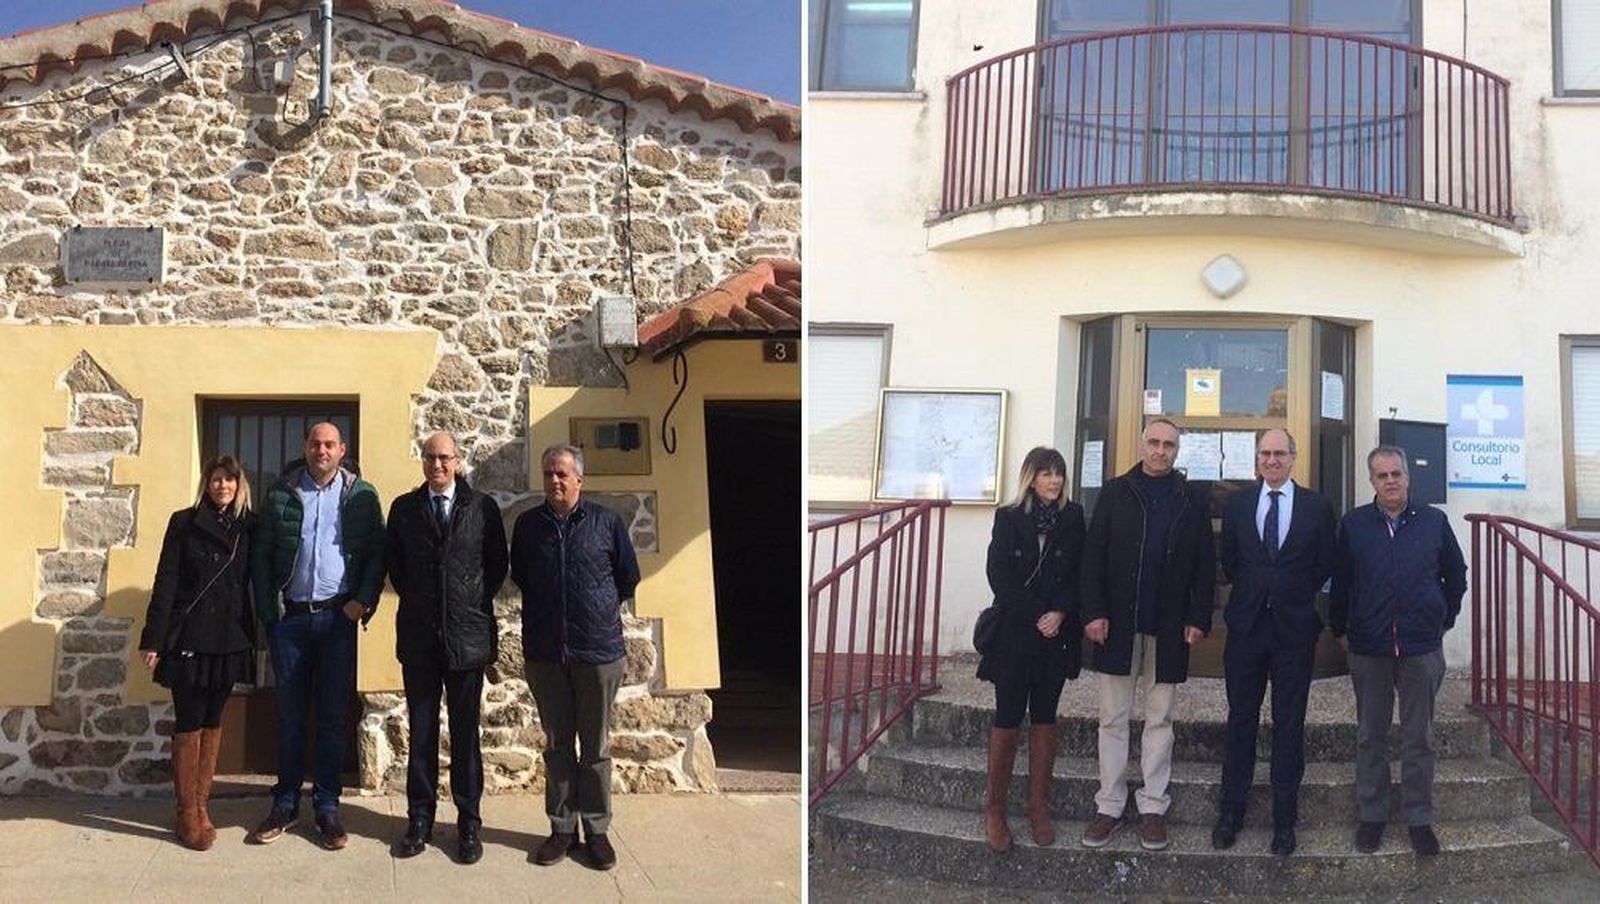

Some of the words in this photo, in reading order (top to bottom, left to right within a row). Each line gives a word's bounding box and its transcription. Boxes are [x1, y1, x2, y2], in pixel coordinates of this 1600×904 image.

[775, 343, 786, 360] 3
[1452, 440, 1520, 454] Consultorio
[1471, 454, 1502, 465] Local
